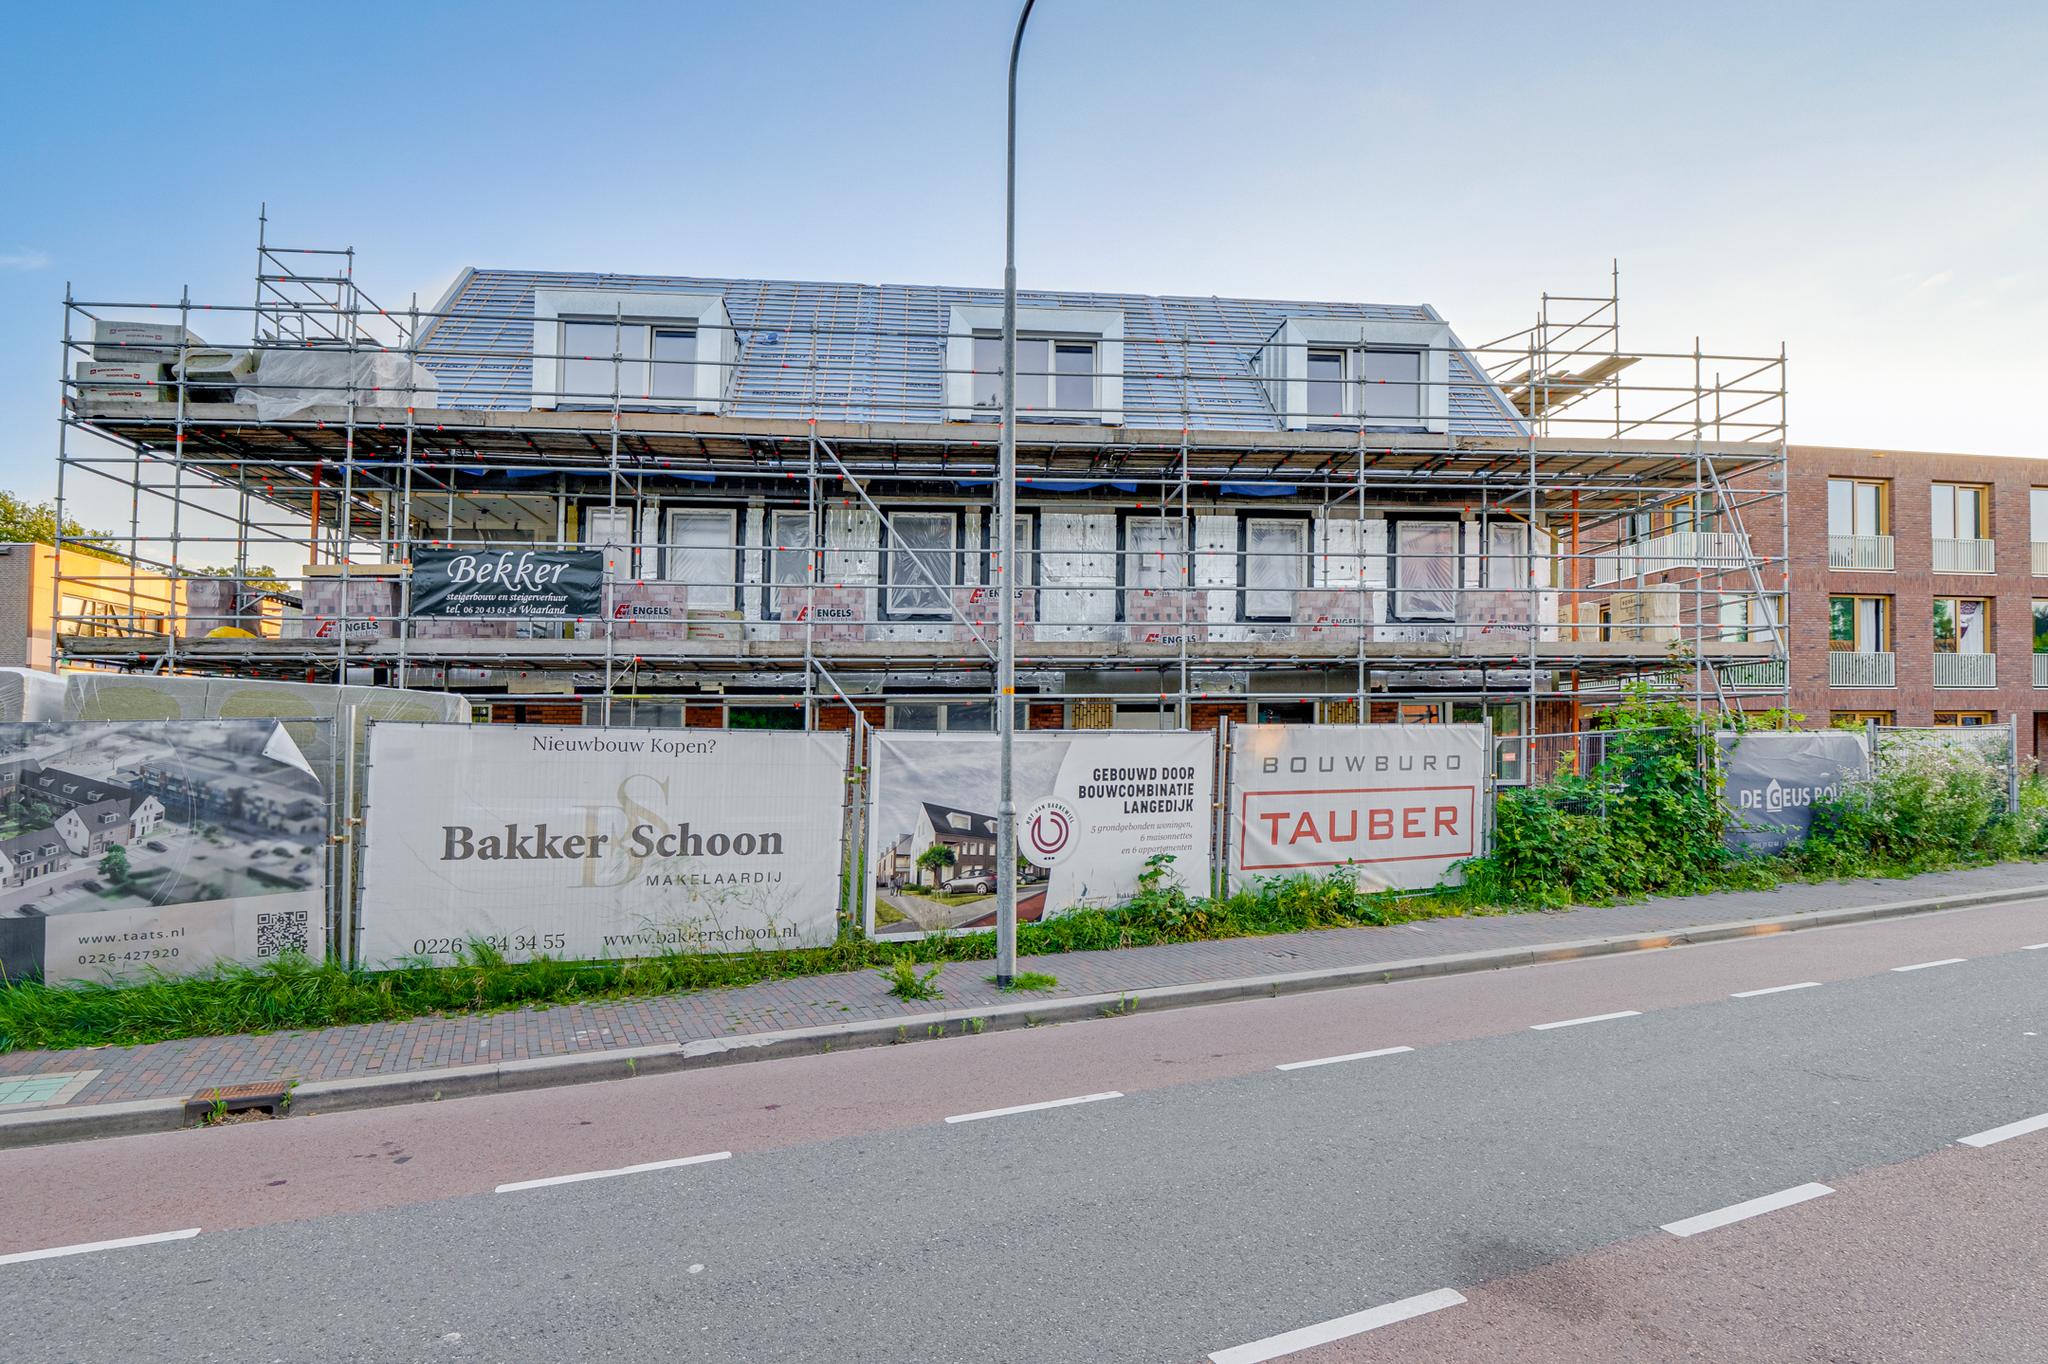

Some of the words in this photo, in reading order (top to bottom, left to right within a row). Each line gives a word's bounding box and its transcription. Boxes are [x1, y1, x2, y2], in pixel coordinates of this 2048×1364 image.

[448, 551, 570, 591] Bekker
[446, 592, 496, 604] steigerbouw
[509, 592, 568, 604] steigerverhuur
[989, 589, 1023, 599] ENLS
[446, 604, 460, 614] tel.
[517, 604, 568, 614] Waarland
[633, 606, 669, 615] ENGELS
[817, 609, 851, 617] ENGELS
[1163, 634, 1196, 644] ENGLS
[532, 735, 645, 753] Nieuwbouw
[650, 737, 717, 757] Kopen?
[1262, 755, 1461, 774] BOUWBURO
[1093, 768, 1157, 781] GEBOUWD
[1162, 767, 1195, 780] DOOR
[1078, 783, 1195, 799] BOUWCOMBINATIE
[1740, 789, 1762, 809] DE
[1768, 785, 1811, 808] GEUS
[1123, 799, 1194, 814] LANGEDIJK
[1091, 825, 1096, 834] 5
[1097, 822, 1155, 834] grondgebonden
[1157, 821, 1193, 831] woningen,
[1260, 806, 1458, 846] TAUBER
[440, 823, 609, 861] Bakker
[630, 822, 784, 859] Schoon
[1140, 834, 1145, 842] 6
[1146, 832, 1193, 841] maisonnettes
[1132, 846, 1137, 854] 6
[646, 872, 783, 887] MAKELAARDIJ
[78, 927, 185, 945] www.taats.nl
[414, 937, 463, 955] 0226
[486, 935, 508, 951] 34
[514, 935, 537, 951] 34
[543, 933, 566, 950] 55
[78, 947, 179, 965] 0226-427920
